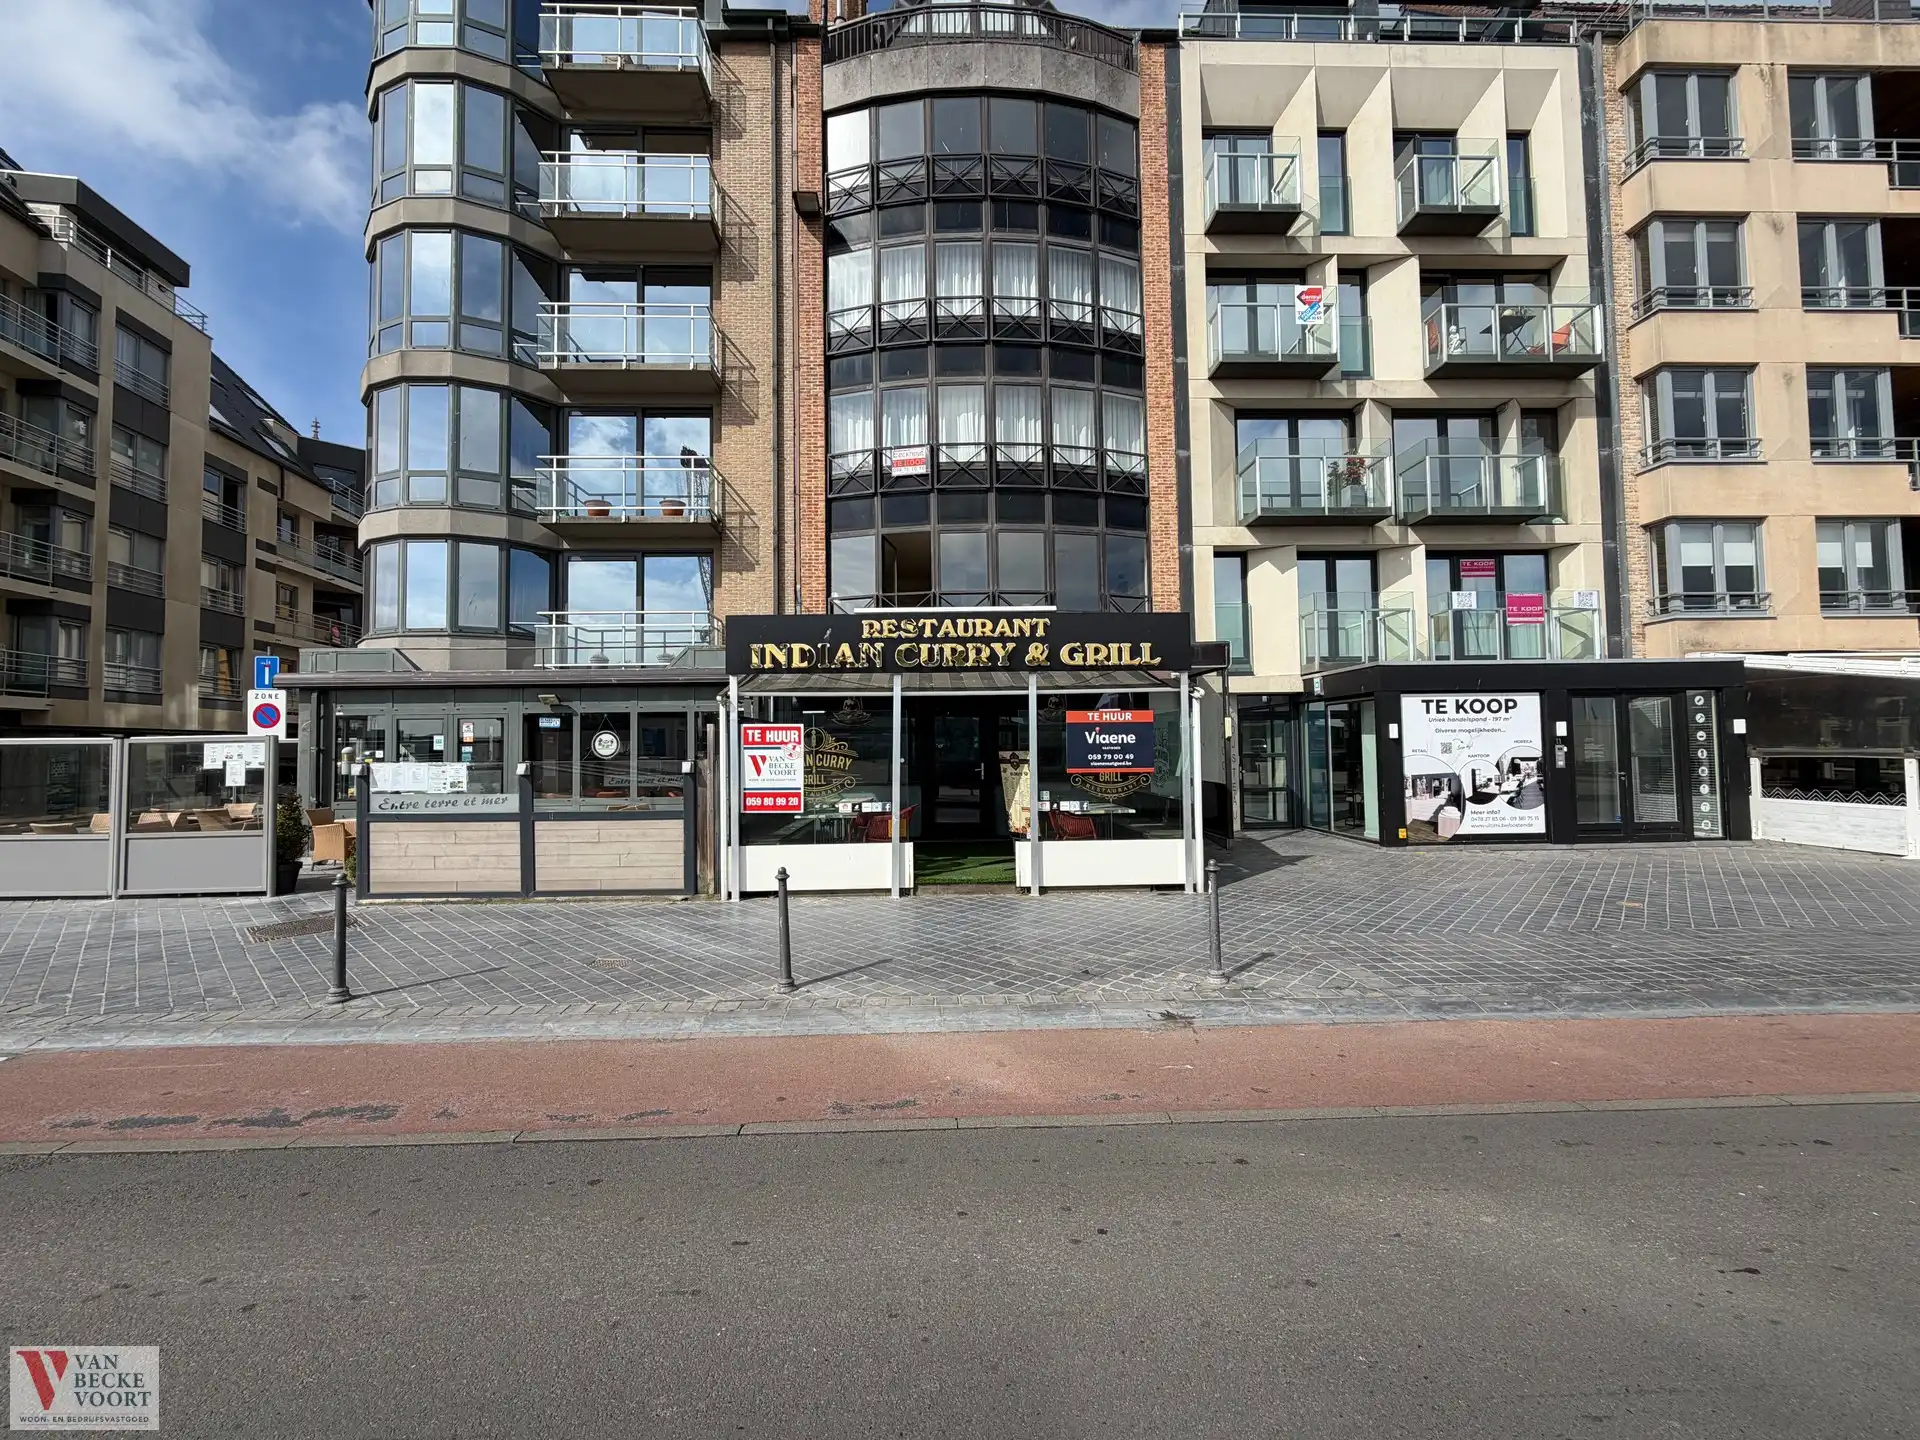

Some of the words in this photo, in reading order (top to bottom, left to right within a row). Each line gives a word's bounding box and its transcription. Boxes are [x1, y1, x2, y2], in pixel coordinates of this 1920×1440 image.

[861, 617, 1051, 639] RESTAURANT
[749, 642, 884, 670] INDIAN
[895, 642, 1017, 668] CURRY
[1024, 642, 1051, 667] &
[1060, 641, 1163, 667] GRILL
[1421, 699, 1448, 714] TE
[1455, 698, 1518, 714] KOOP
[1087, 712, 1100, 720] TE
[1103, 712, 1132, 720] HUUR
[746, 730, 762, 742] TE
[766, 730, 799, 742] HUUR
[1085, 729, 1137, 744] Viaene
[816, 754, 853, 770] CURRY
[1099, 772, 1123, 782] GRILL
[378, 798, 420, 810] Entre
[424, 799, 459, 809] terre
[463, 797, 477, 806] et
[481, 796, 508, 805] mer
[746, 797, 762, 806] 059
[764, 797, 774, 806] 80
[776, 797, 787, 806] 99
